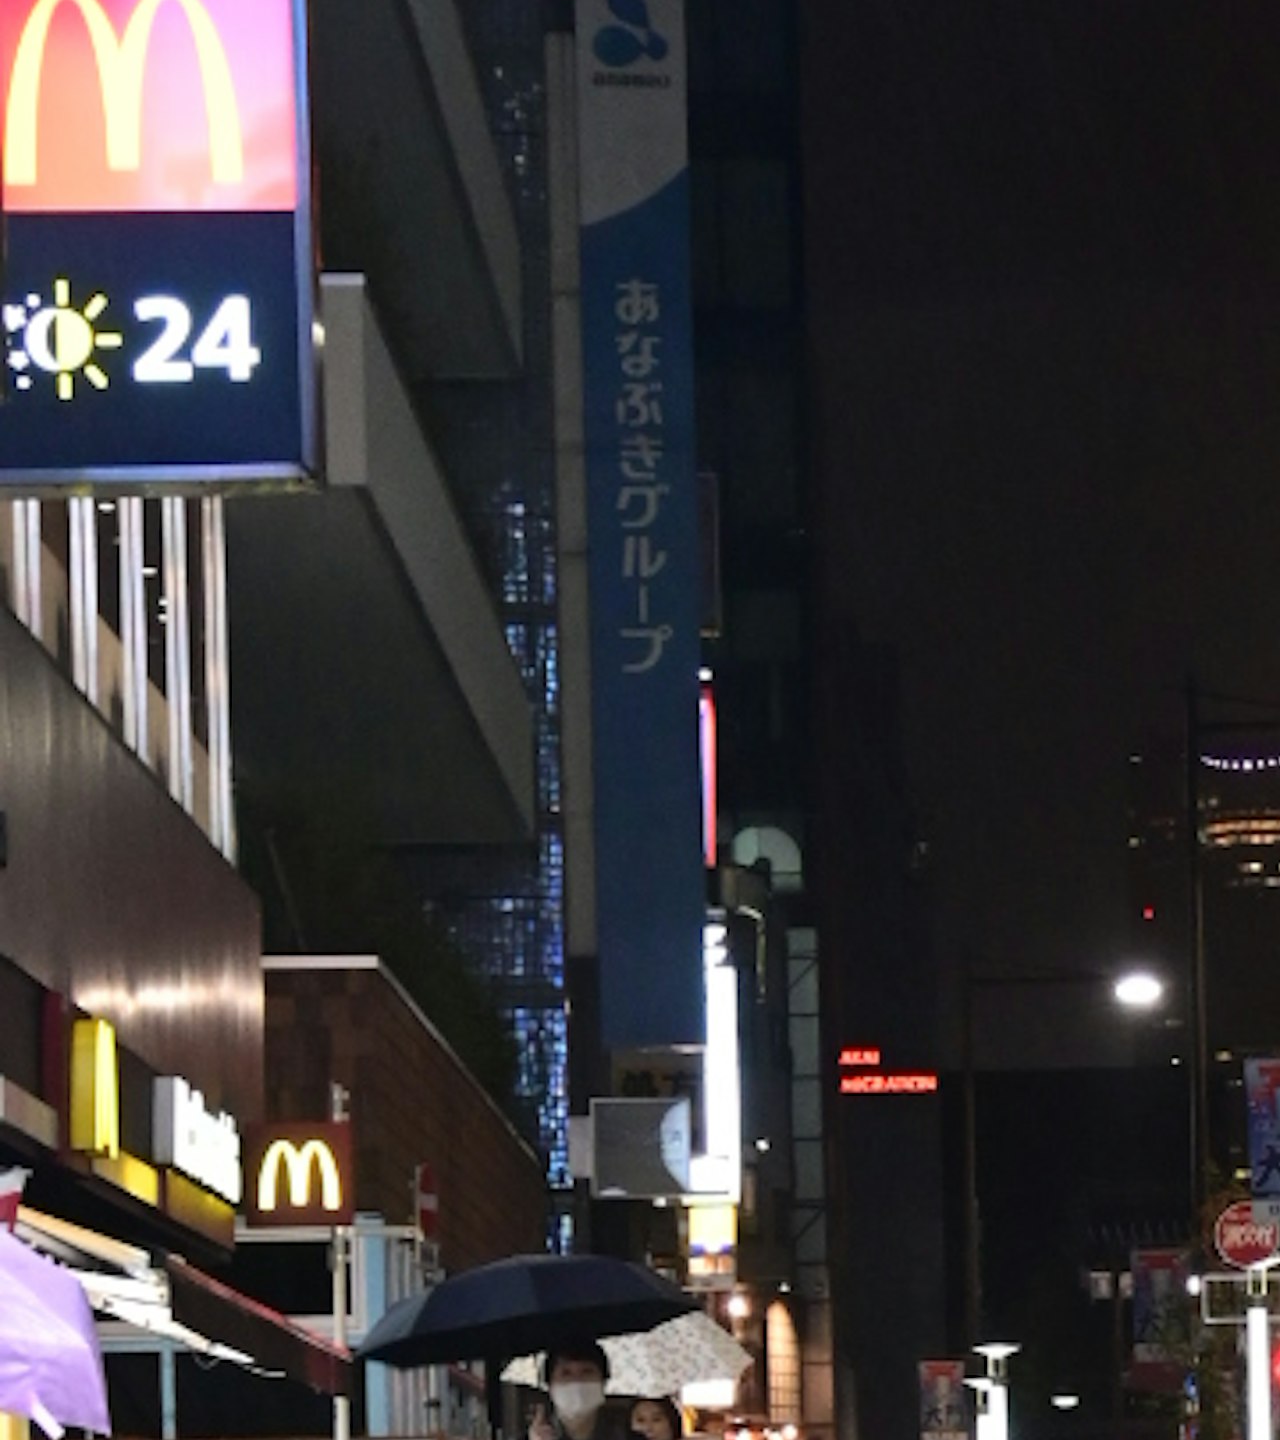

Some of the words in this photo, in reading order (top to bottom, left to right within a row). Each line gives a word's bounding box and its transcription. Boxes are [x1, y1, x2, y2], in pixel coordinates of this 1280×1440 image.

[133, 294, 261, 383] 24
[614, 277, 675, 675] あなぶきグループ
